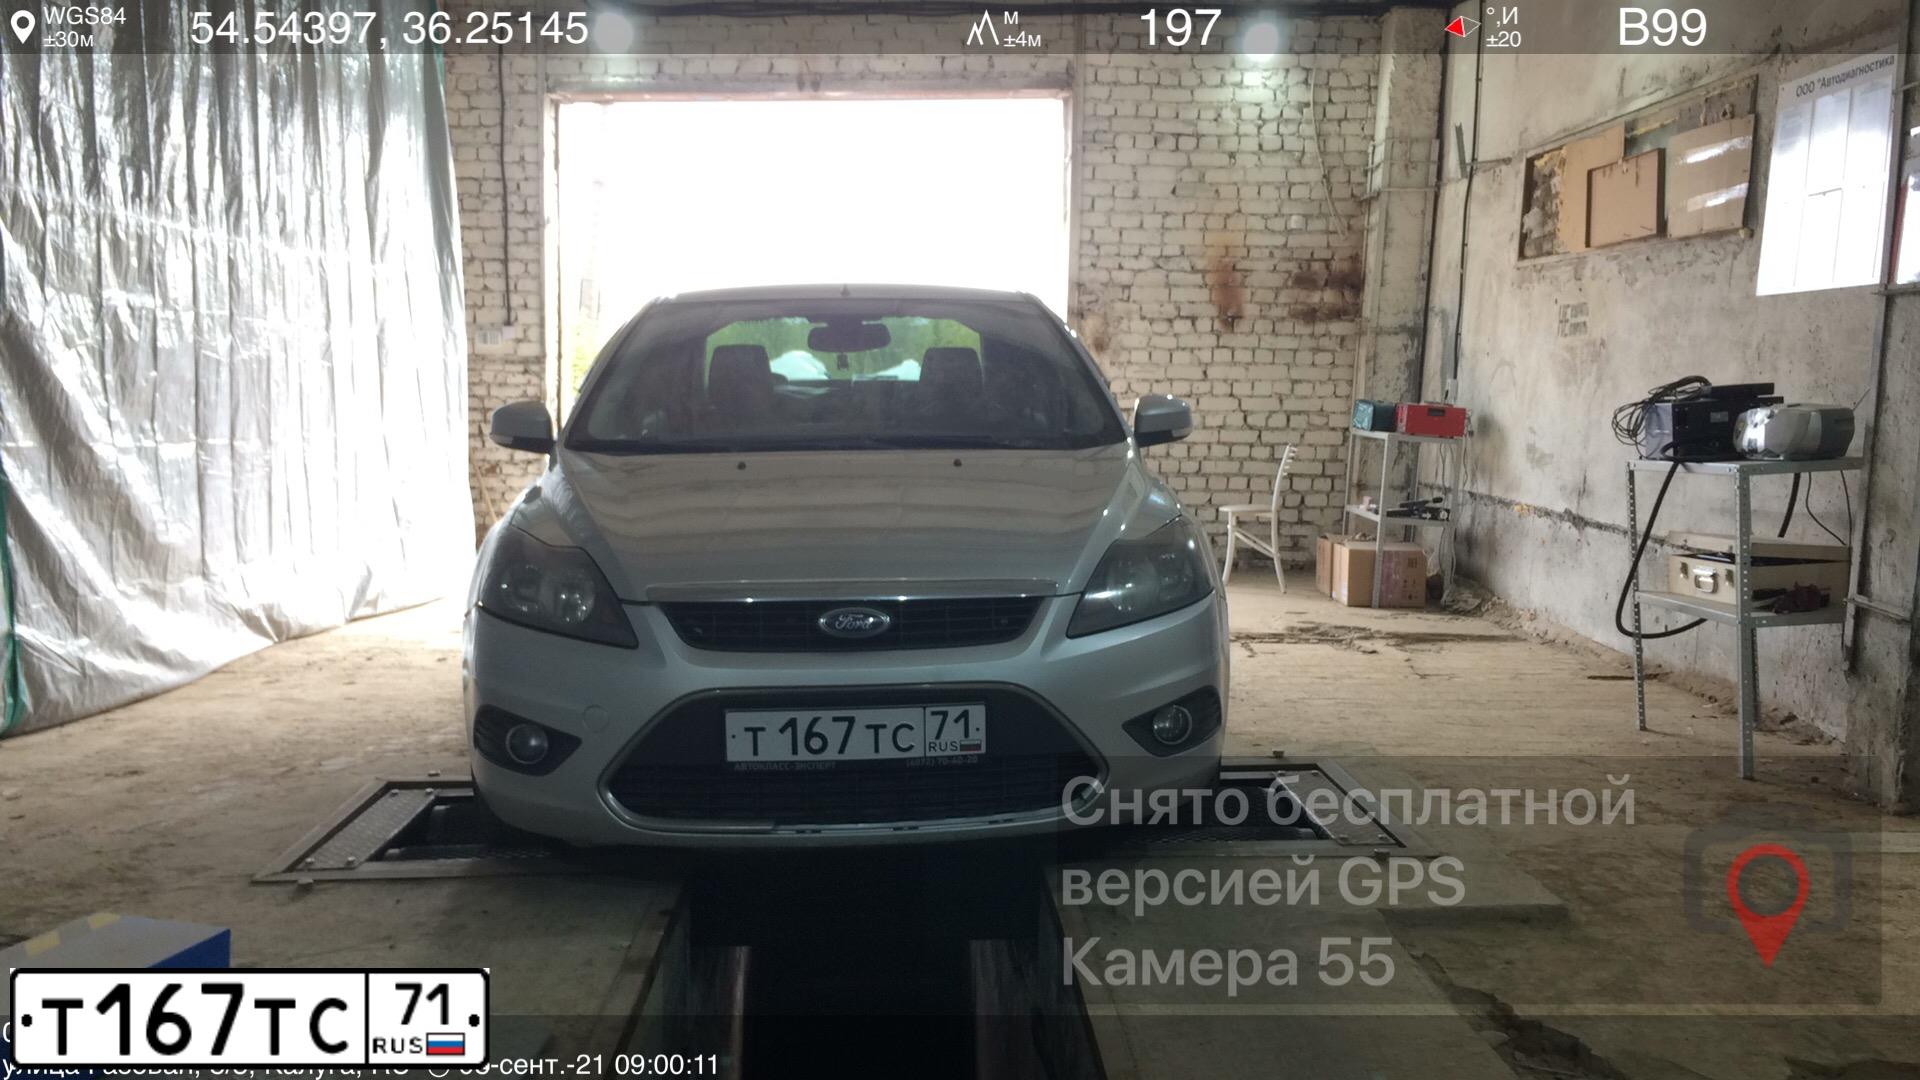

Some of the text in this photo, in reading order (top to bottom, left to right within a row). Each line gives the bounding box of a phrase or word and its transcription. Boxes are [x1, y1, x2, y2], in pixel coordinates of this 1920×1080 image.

[1796, 80, 1815, 98] ООО
[835, 613, 874, 630] Ford
[930, 709, 970, 740] 71
[928, 740, 958, 753] RUS
